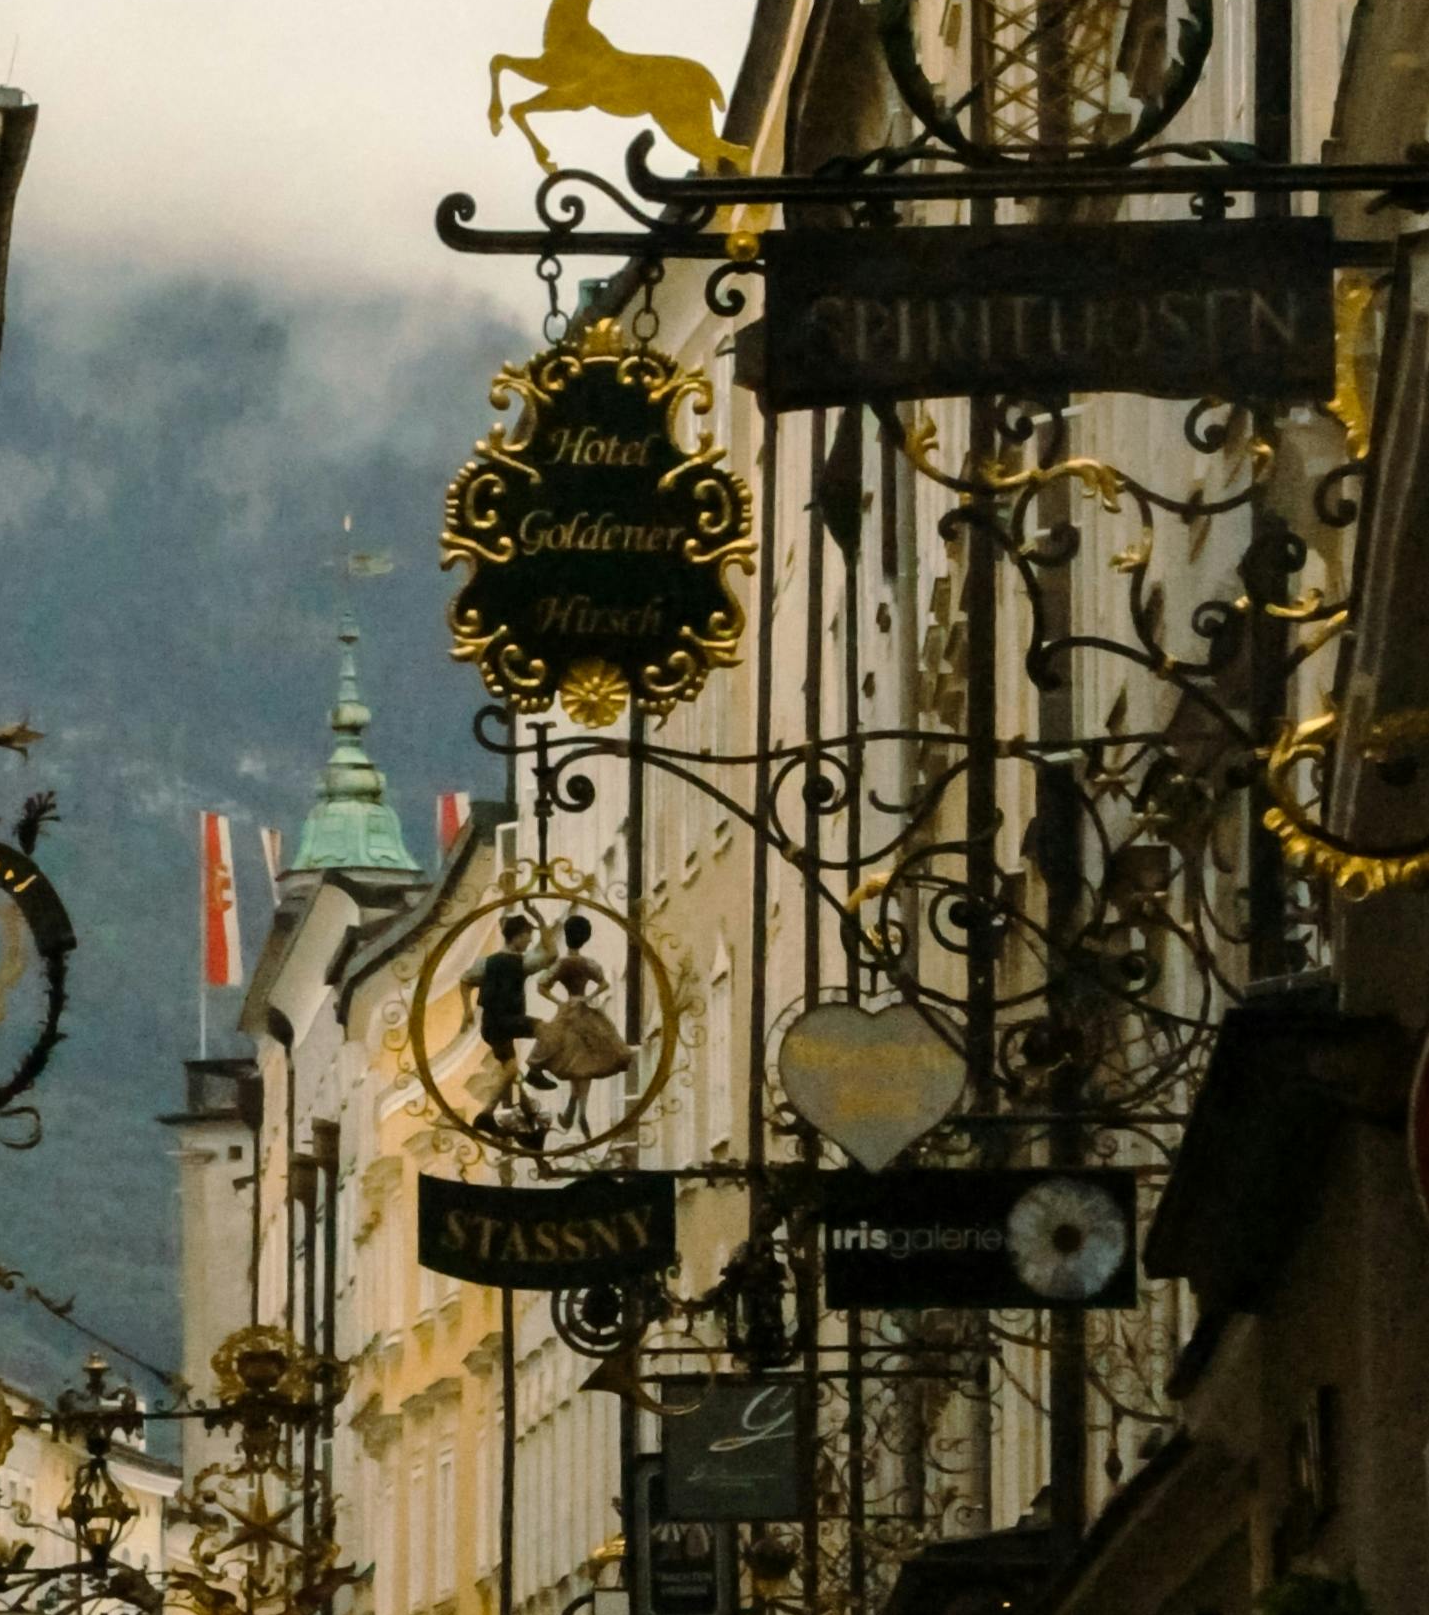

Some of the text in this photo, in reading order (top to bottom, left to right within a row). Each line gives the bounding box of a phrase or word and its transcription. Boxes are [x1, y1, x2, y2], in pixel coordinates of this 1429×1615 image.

[805, 290, 1300, 364] SPIRITUOSEN
[546, 425, 659, 469] Hotel
[518, 509, 685, 557] Goldener
[533, 594, 665, 638] Hirsch
[440, 1203, 654, 1263] STASSNY
